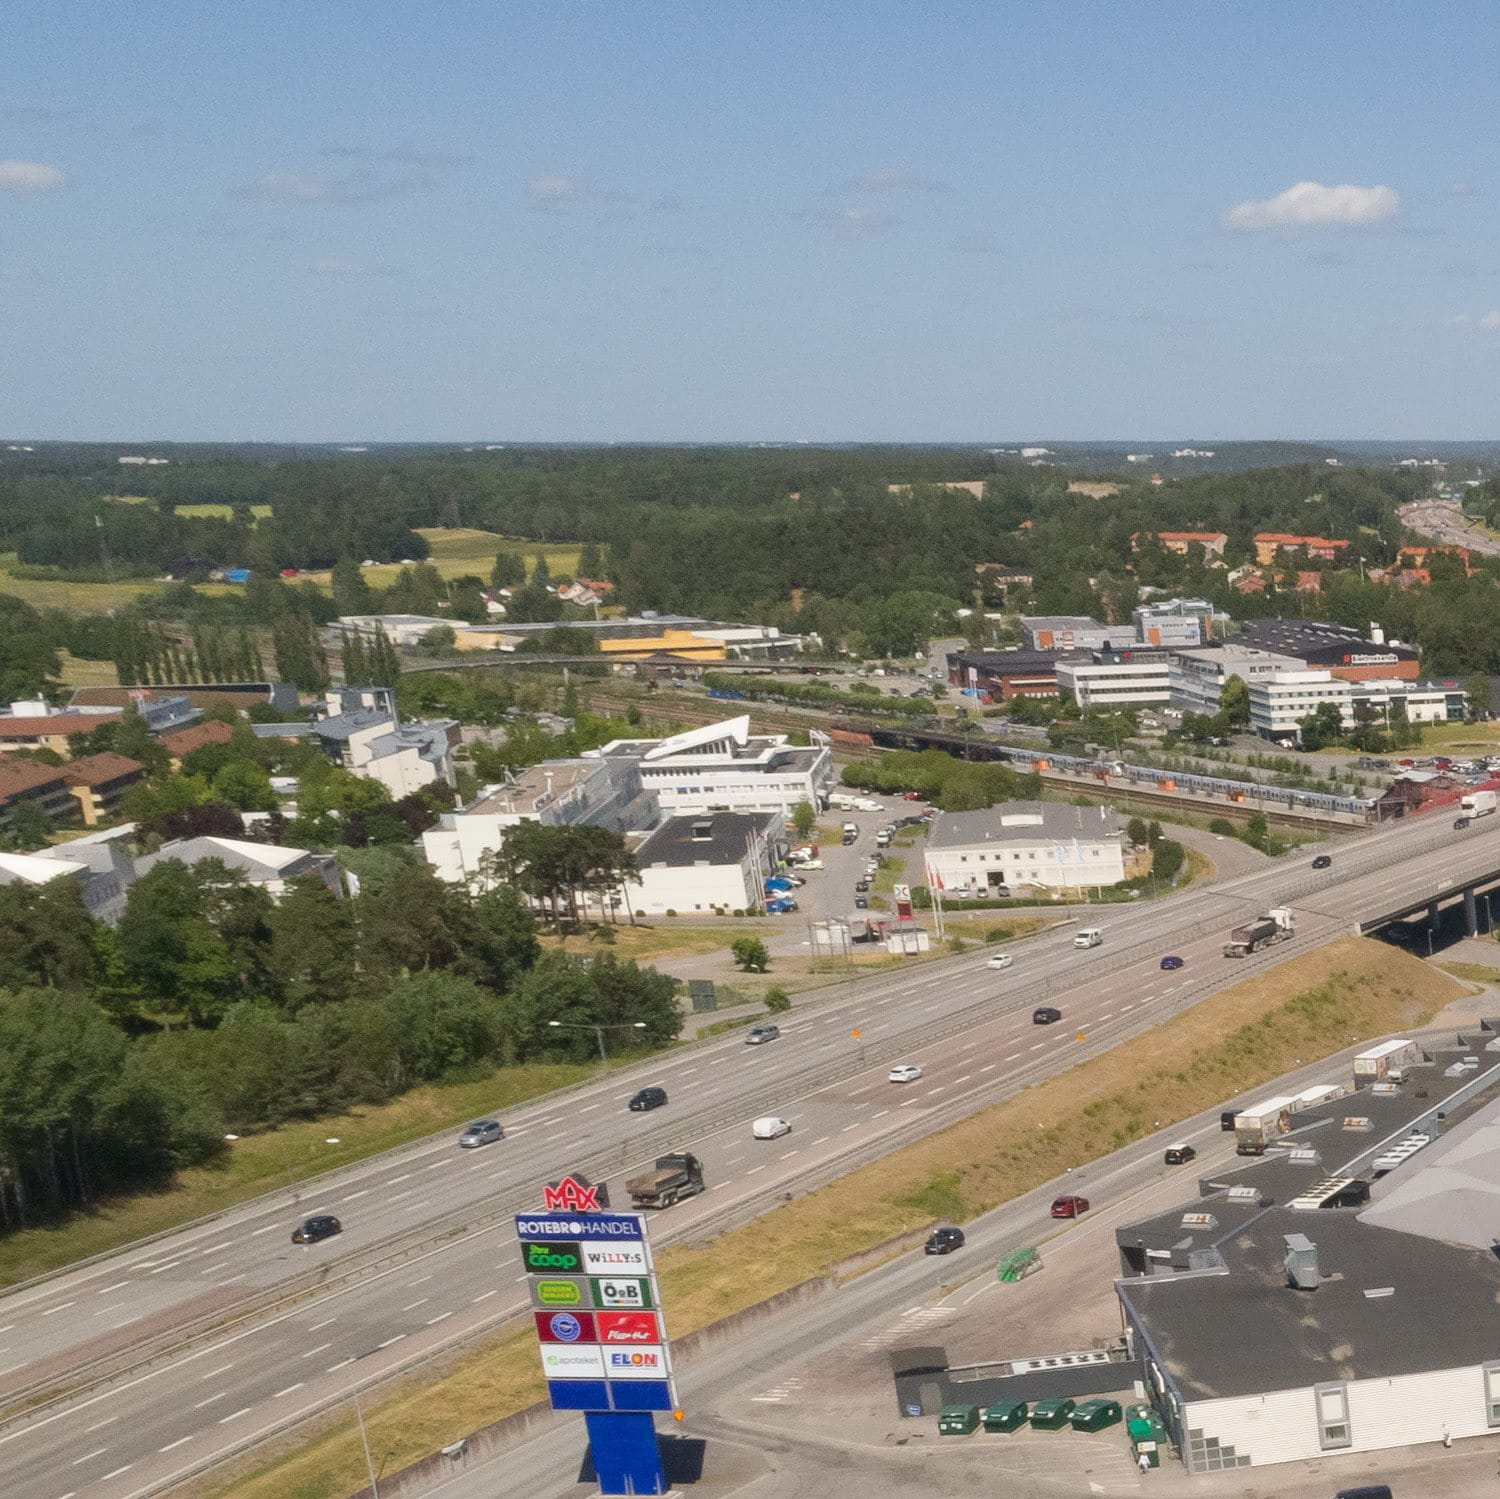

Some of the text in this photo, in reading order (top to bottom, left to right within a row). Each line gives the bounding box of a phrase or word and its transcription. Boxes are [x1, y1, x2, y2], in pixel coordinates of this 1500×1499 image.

[543, 1176, 601, 1211] MAX
[529, 1254, 577, 1269] coop
[611, 1353, 658, 1365] ELON
